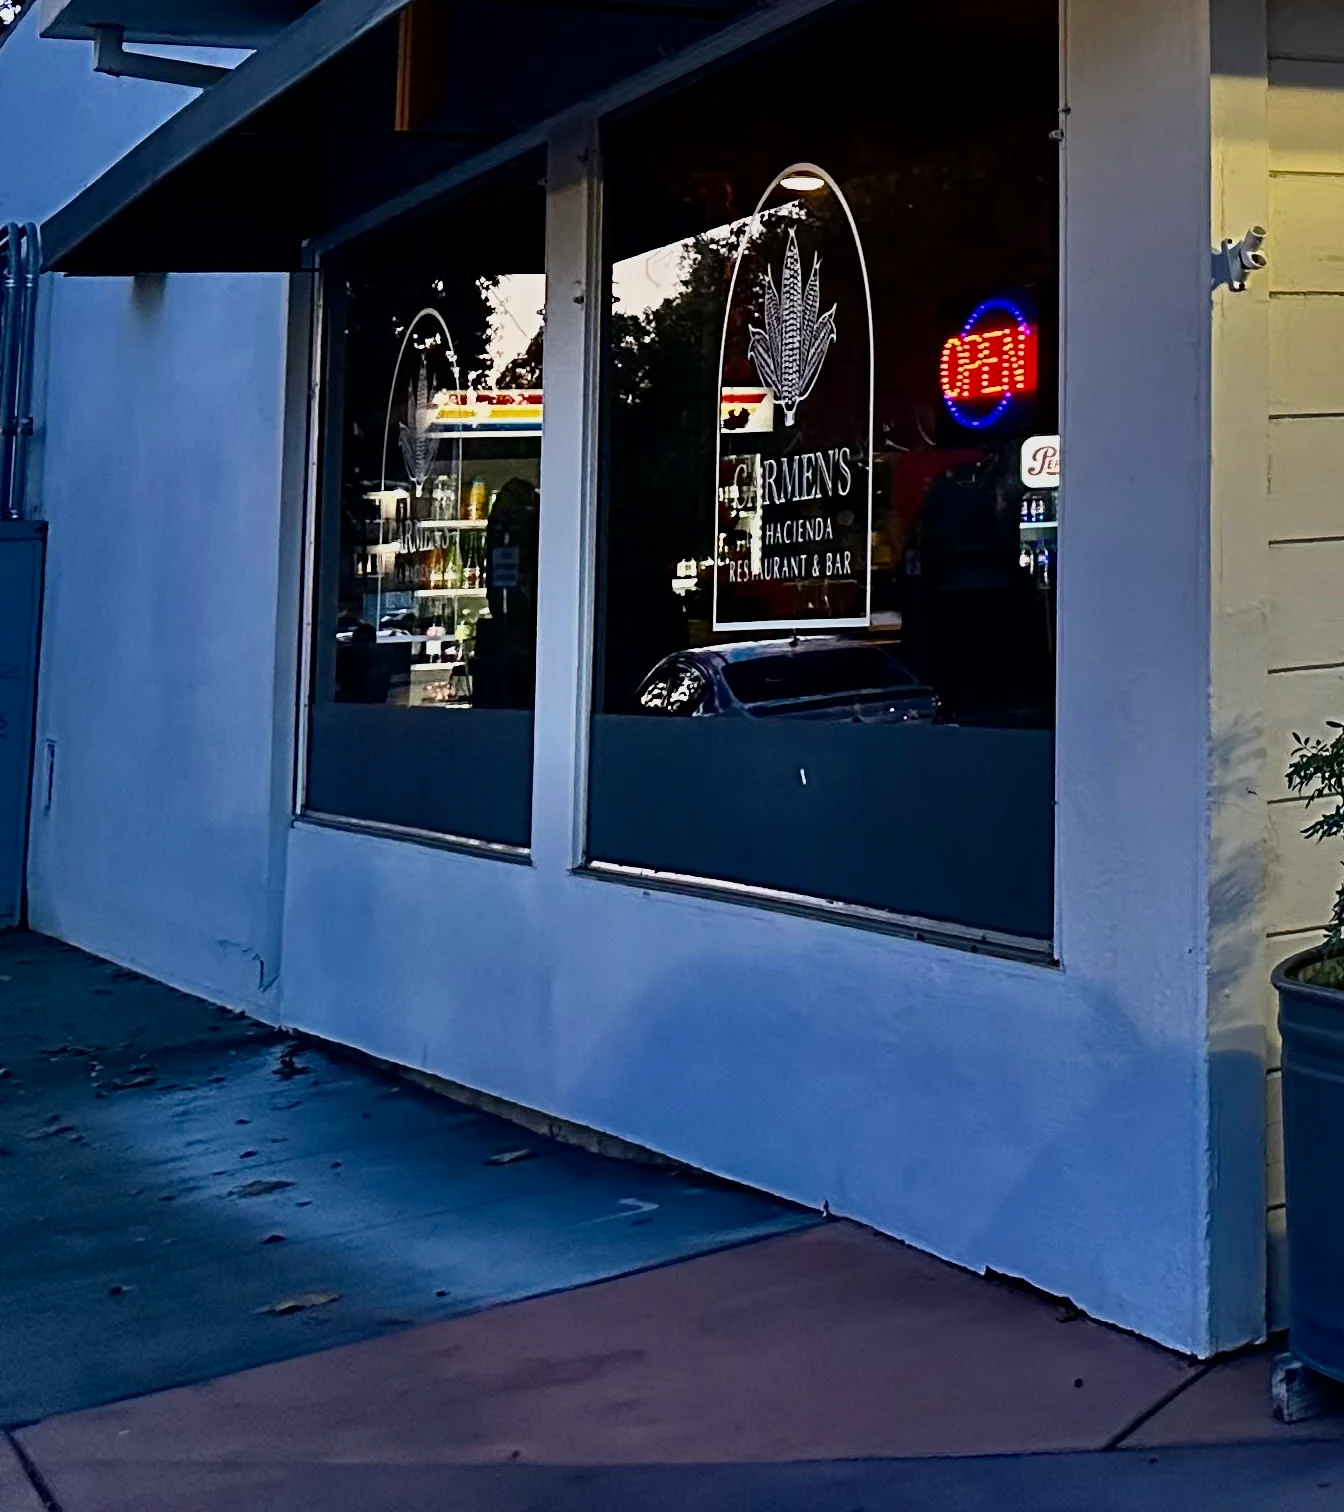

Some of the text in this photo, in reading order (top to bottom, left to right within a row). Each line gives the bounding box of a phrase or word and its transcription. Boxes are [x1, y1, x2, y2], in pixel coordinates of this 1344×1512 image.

[940, 327, 1025, 398] OPEN
[766, 517, 833, 545] HACIENDA
[729, 551, 852, 583] RESURANT & BAR
